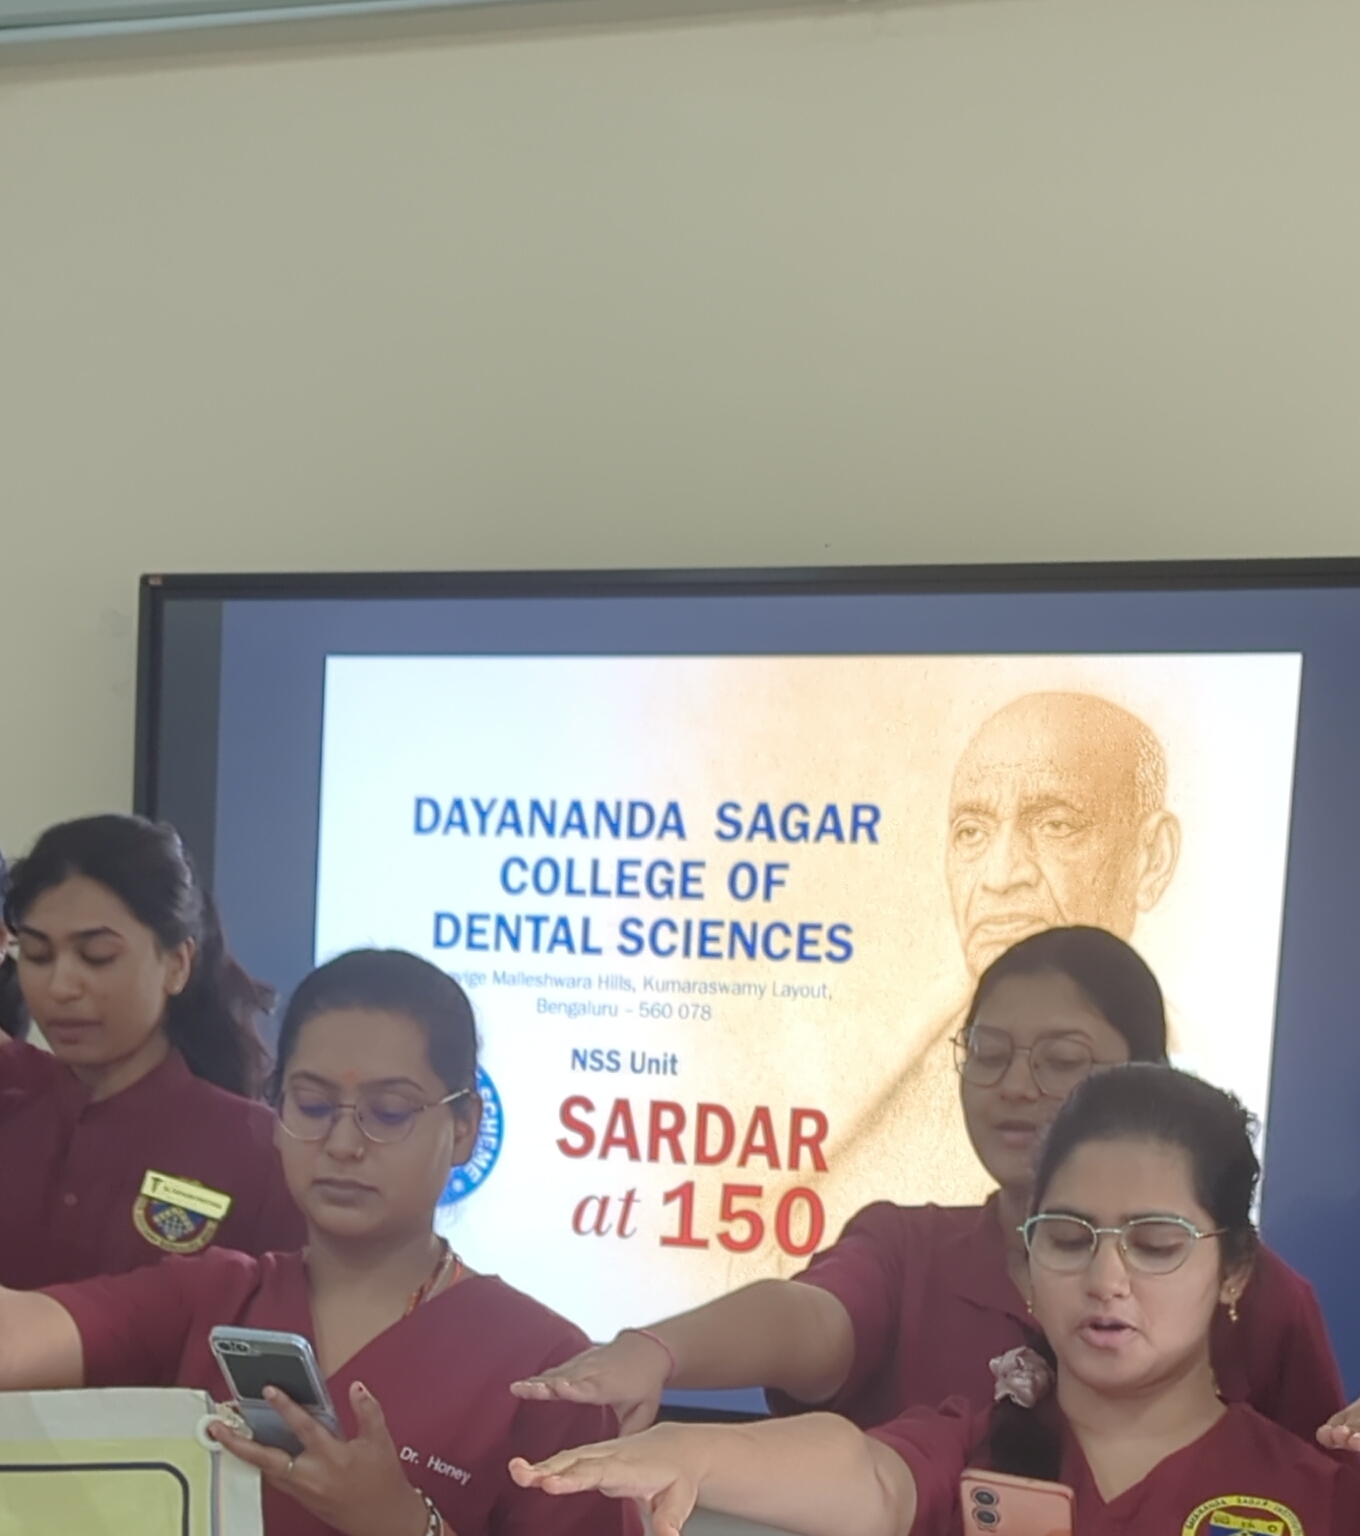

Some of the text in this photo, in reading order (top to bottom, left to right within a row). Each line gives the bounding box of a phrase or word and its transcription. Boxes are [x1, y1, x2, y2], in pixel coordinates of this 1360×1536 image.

[413, 797, 882, 844] DAYANANDA SAGAR
[500, 856, 790, 902] COLLEGE OF
[432, 911, 855, 963] DENTAL SCIENCES
[492, 970, 592, 990] Malleshwara
[598, 974, 636, 993] Hills,
[643, 976, 767, 999] Kumaraswamy
[772, 980, 833, 1001] Layout,
[537, 998, 618, 1019] Bengaluru
[639, 1002, 673, 1019] 560
[678, 1003, 712, 1021] 078
[571, 1048, 678, 1075] NSS Unit
[556, 1094, 829, 1173] SARDAR
[571, 1180, 826, 1258] at 150
[400, 1446, 471, 1486] Dr. Honey
